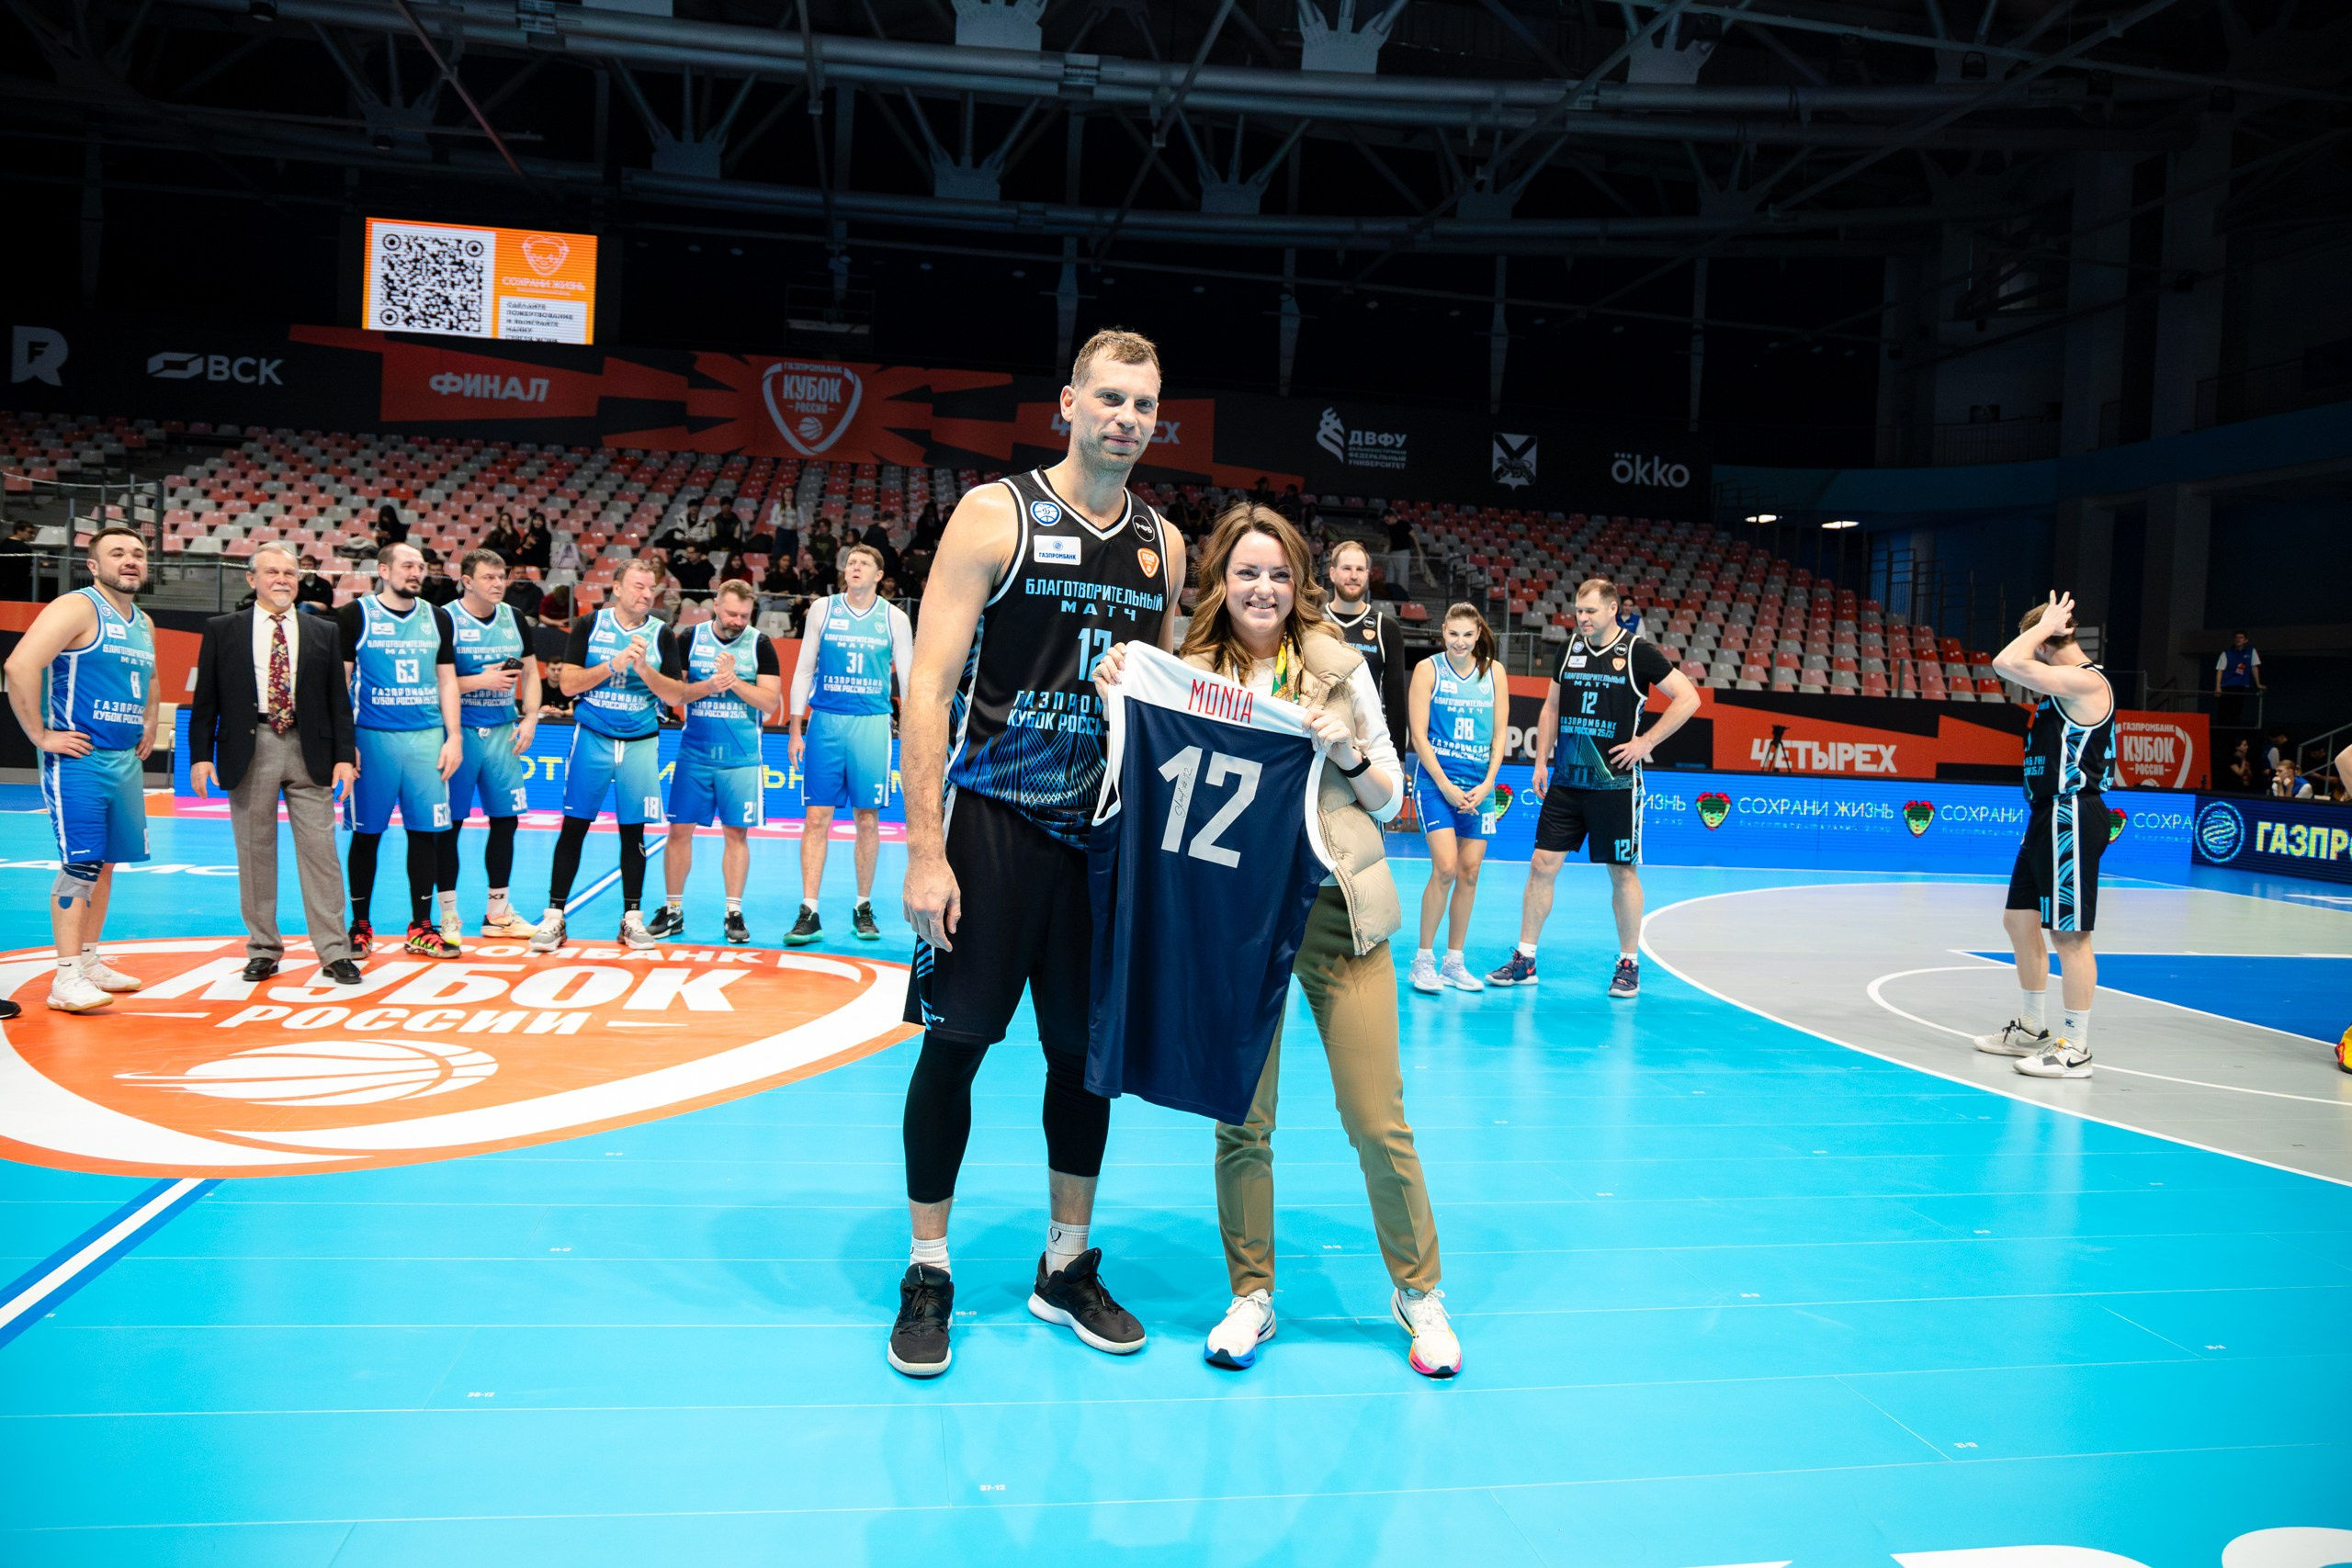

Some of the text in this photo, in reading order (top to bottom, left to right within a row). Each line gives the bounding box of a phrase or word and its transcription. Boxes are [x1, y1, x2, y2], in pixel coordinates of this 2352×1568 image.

[207, 355, 283, 385] ВСК
[429, 372, 549, 402] ФИНАЛ
[783, 375, 842, 402] КУБОК
[1349, 430, 1407, 447] ДВФУ
[1349, 460, 1406, 469] УНИВЕРСИТЕТ
[1039, 552, 1076, 560] ГАЗПРОМБАНК
[1025, 579, 1162, 612] БЛАГОТВОРИТЕЛЬНЫЙ
[1061, 601, 1136, 622] МАТЧ
[837, 642, 875, 650] МАТЧ
[1078, 628, 1113, 682] 12
[395, 660, 419, 682] 63
[846, 652, 864, 674] 31
[130, 671, 141, 698] 8
[1564, 671, 1625, 685] БЛАГОТВОРИТЕЛЬНЫЙ
[1574, 681, 1610, 689] МАТЧ
[1013, 690, 1104, 716] ГАЗПРОМ
[1188, 679, 1254, 724] MONIA
[1581, 691, 1598, 714] 12
[93, 710, 122, 723] КУБОК
[1007, 709, 1106, 737] КУБОК РОССИ
[2122, 722, 2175, 733] ГАЗПРОМБАНК
[1453, 717, 1475, 740] 88
[1750, 738, 1897, 773] ЧЕТЫРЕХ
[2123, 736, 2176, 763] КУБОК
[2135, 763, 2164, 775] РОССИИ
[644, 796, 659, 819] 18
[1158, 745, 1263, 868] 12
[1737, 796, 1894, 819] СОХРАНИ ЖИЗНЬ
[1940, 805, 2023, 823] СОХРАНИ
[1614, 839, 1631, 862] 12
[127, 957, 752, 1011] КУБОК
[213, 1005, 592, 1035] РОССИИ
